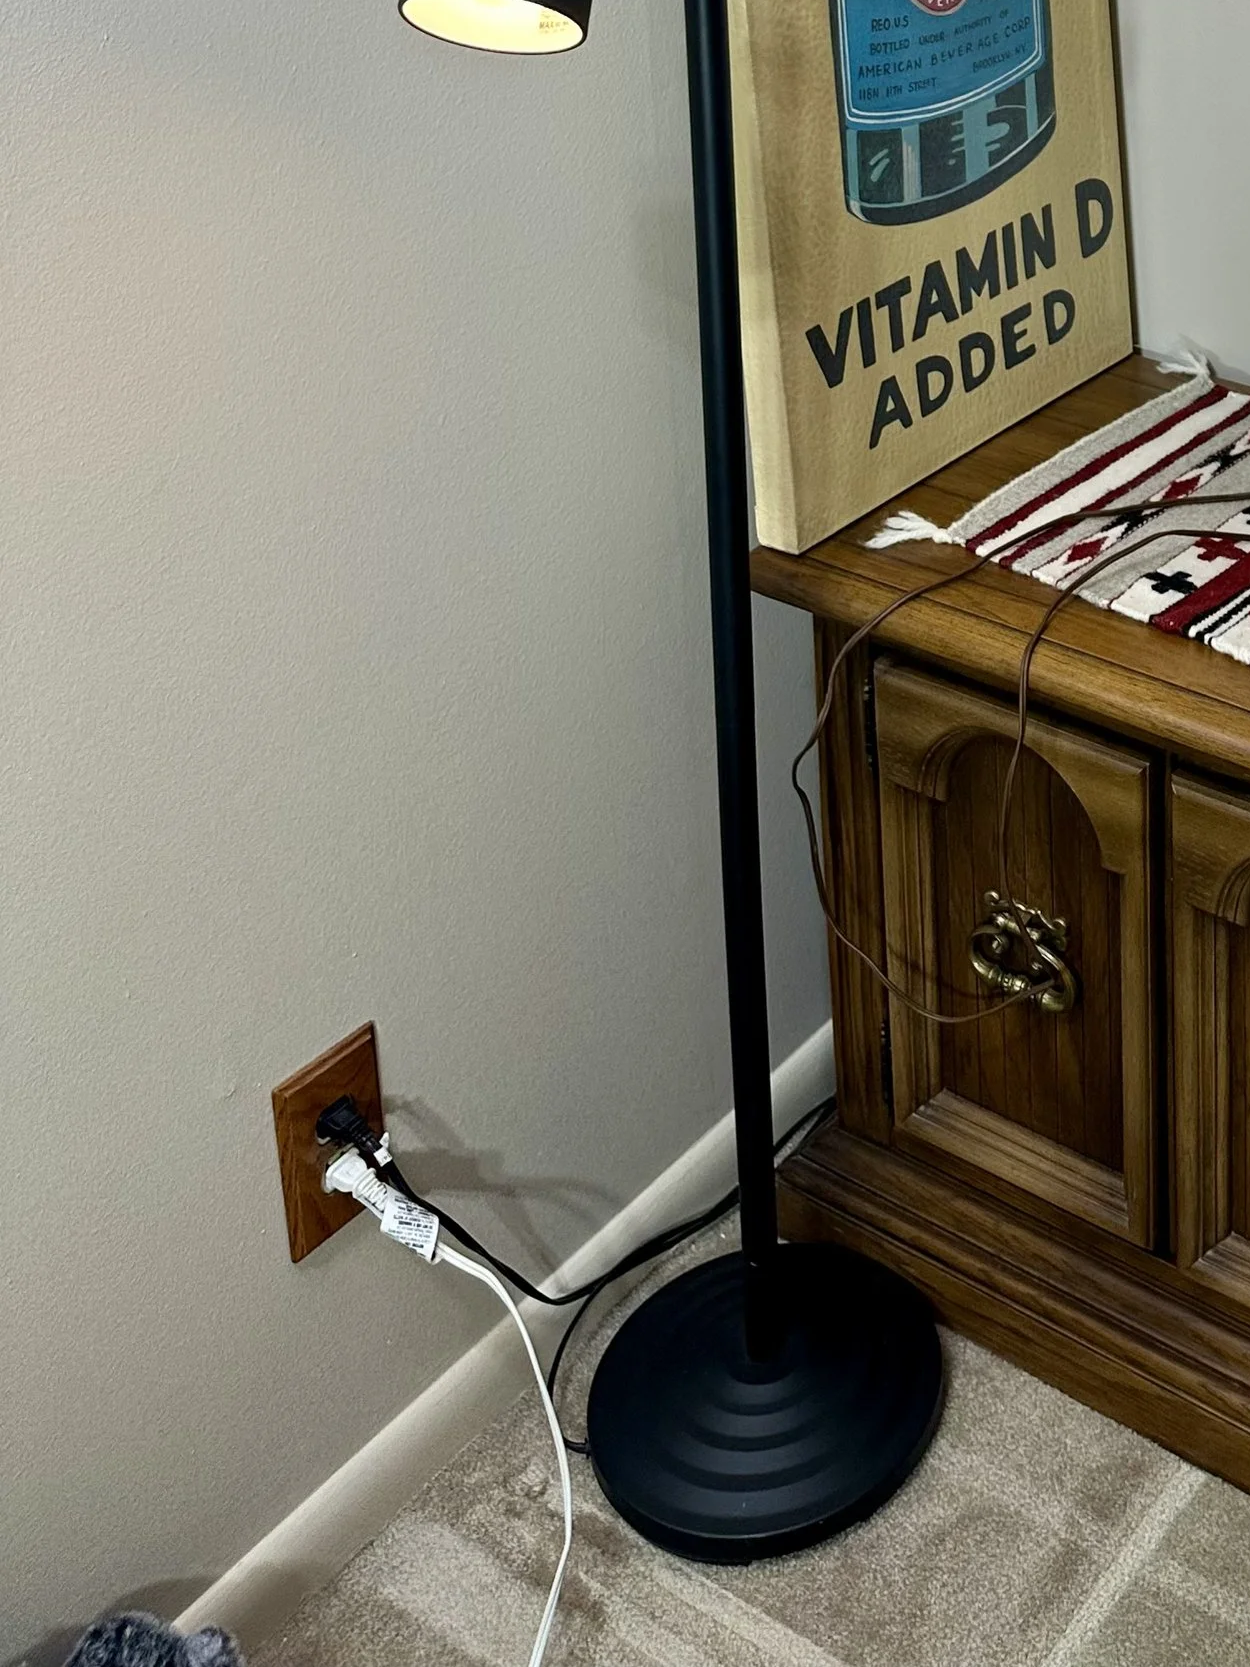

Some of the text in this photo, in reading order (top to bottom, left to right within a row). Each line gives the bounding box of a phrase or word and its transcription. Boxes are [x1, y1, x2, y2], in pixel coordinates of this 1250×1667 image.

[858, 59, 922, 80] AMERICAN
[1005, 16, 1031, 39] CORP
[805, 178, 1114, 389] VITAMIN D
[869, 289, 1076, 450] ADDED
